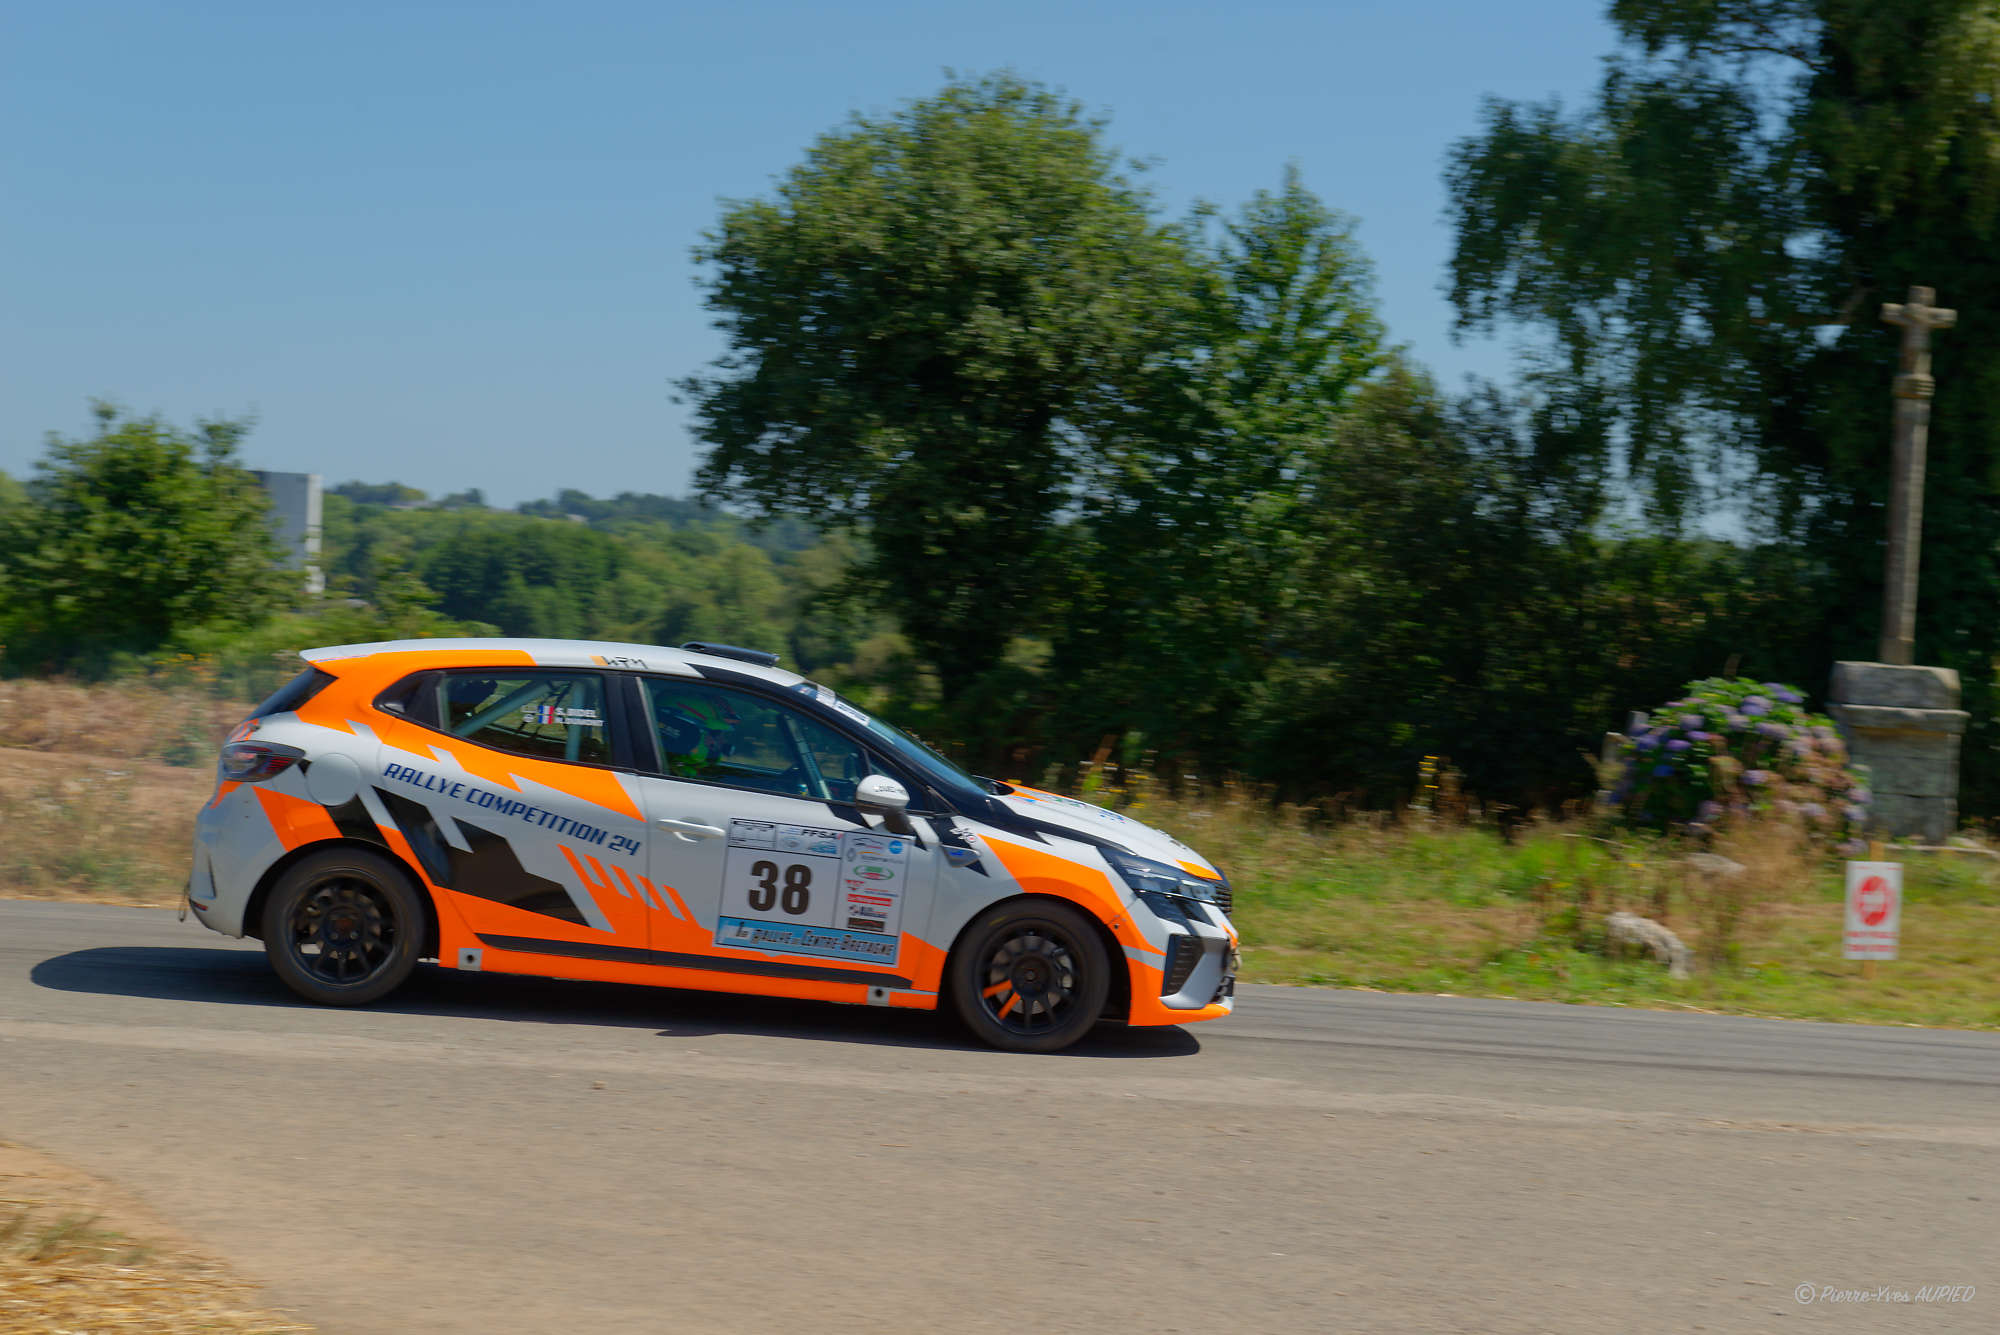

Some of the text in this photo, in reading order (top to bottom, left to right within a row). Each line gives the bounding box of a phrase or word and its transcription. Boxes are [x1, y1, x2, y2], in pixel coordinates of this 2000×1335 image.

[384, 762, 641, 857] RALLYE COMPETITION 24
[801, 828, 837, 839] FFSA
[748, 860, 812, 916] 38
